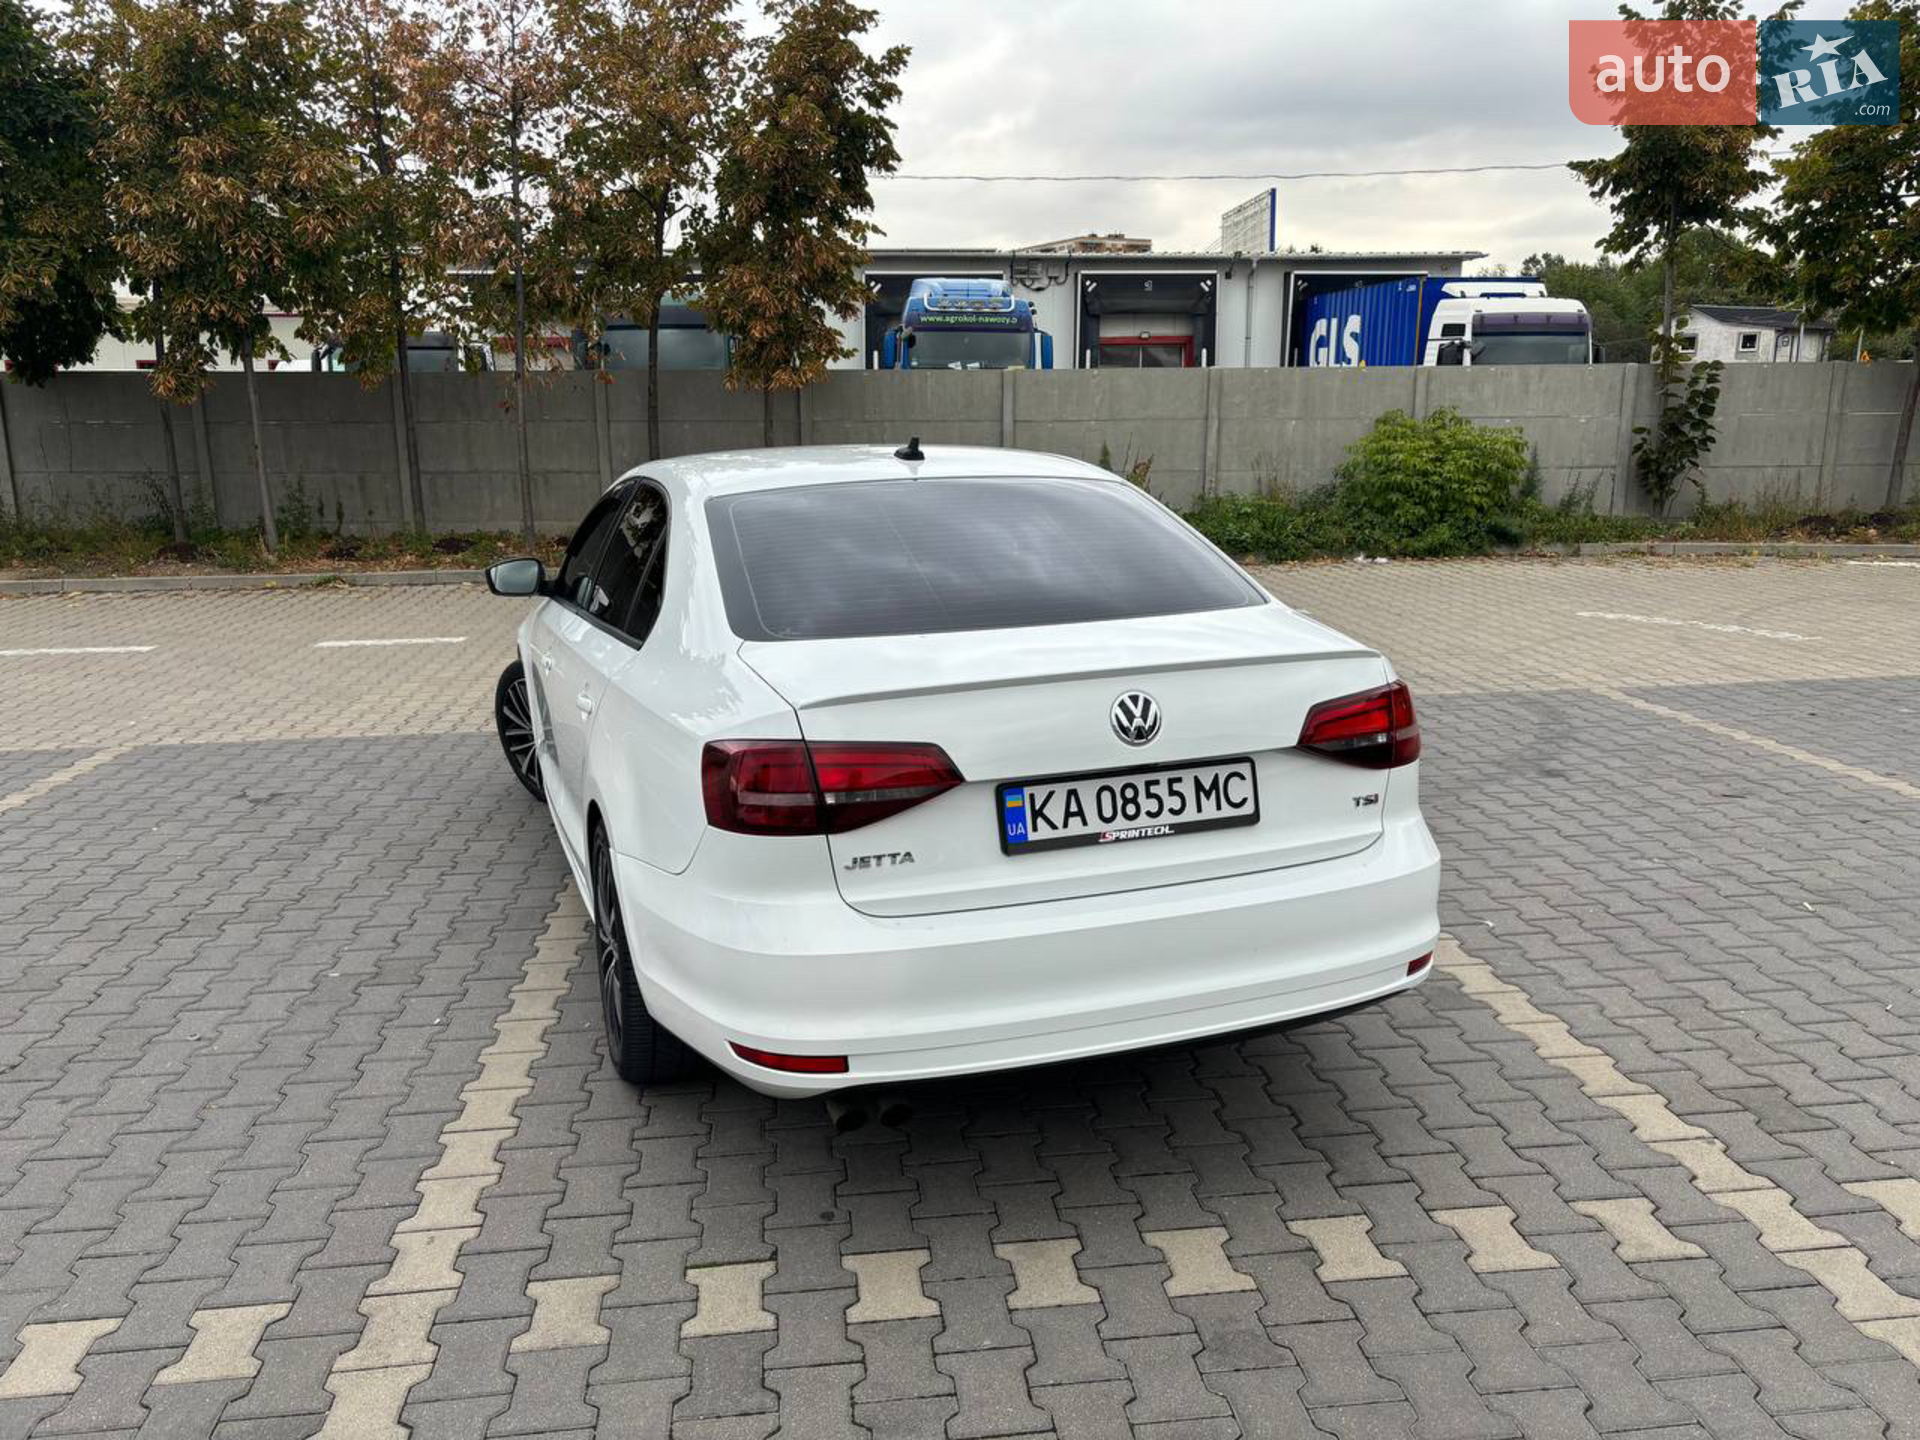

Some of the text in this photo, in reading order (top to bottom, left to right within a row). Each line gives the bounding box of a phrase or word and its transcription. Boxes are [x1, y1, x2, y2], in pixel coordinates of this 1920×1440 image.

[1029, 771, 1249, 832] KA 0855 MC
[1352, 793, 1379, 807] TSI
[1008, 820, 1026, 836] UA
[844, 851, 915, 870] JETTA
